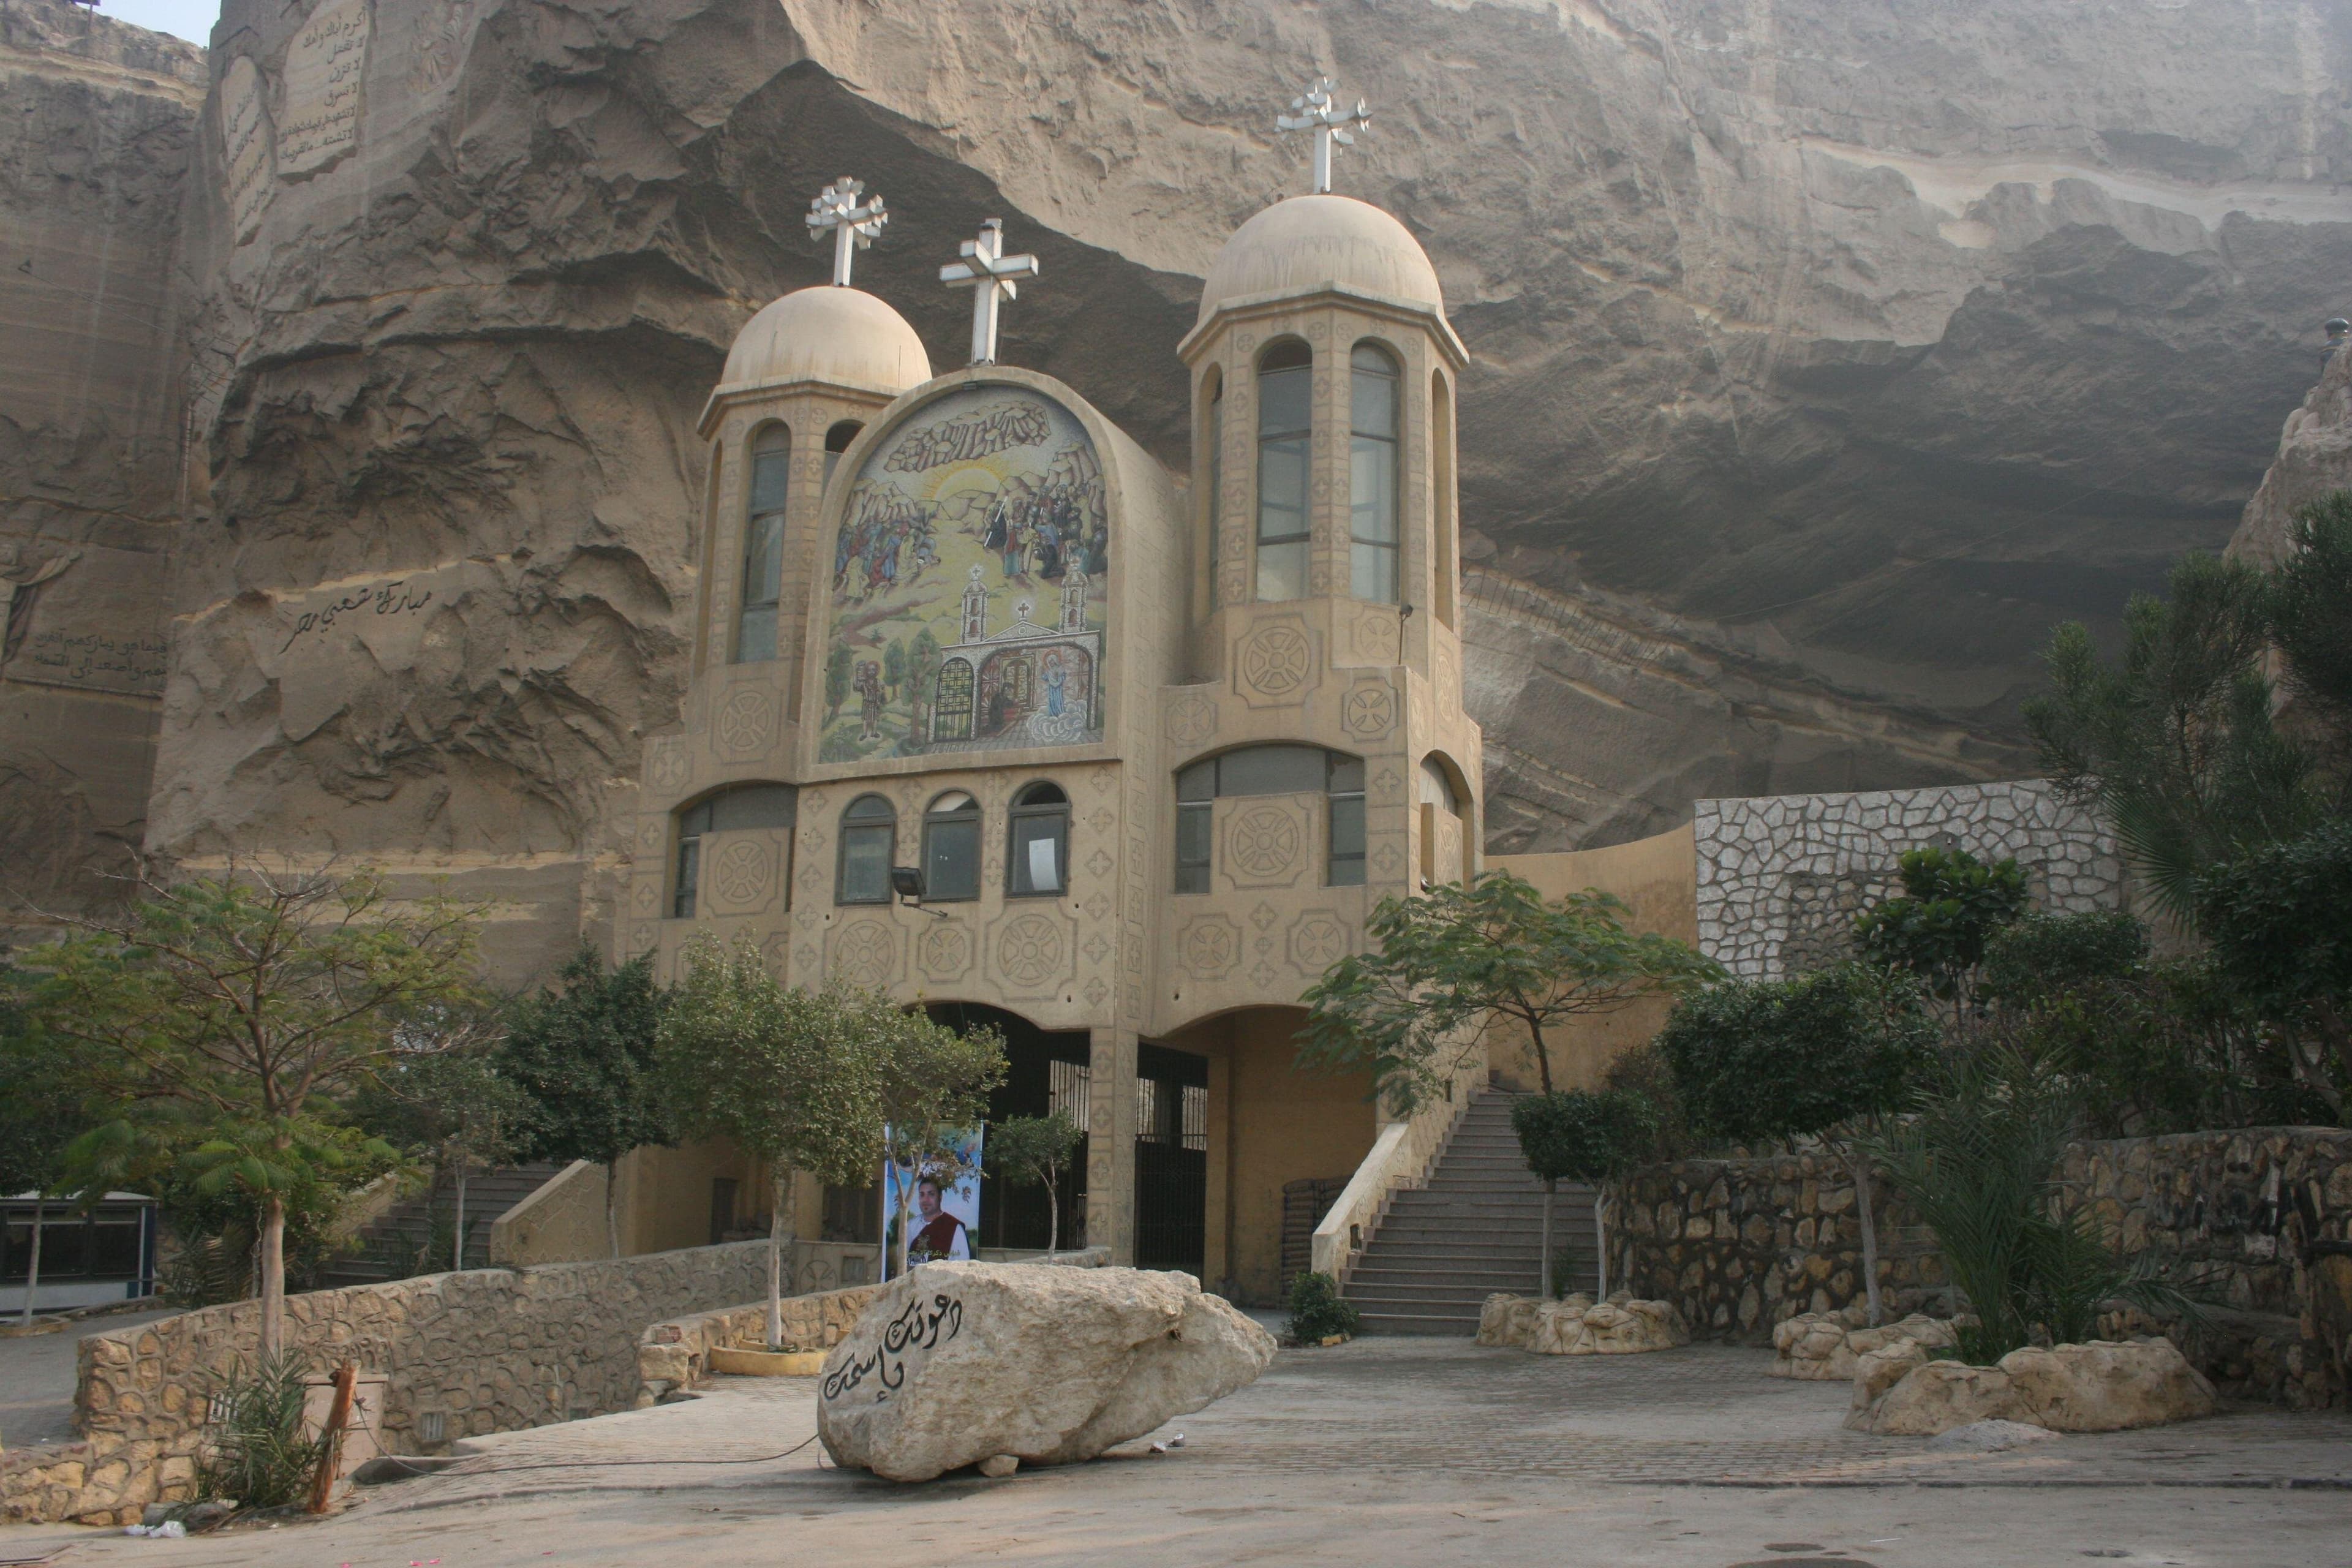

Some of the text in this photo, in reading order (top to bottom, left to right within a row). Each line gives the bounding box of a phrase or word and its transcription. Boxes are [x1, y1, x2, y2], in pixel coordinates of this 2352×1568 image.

[357, 35, 366, 48] لا
[353, 56, 361, 70] لا
[325, 81, 358, 107] لا تسرق
[322, 588, 372, 633] شعبي
[884, 1294, 962, 1354] دعوتك
